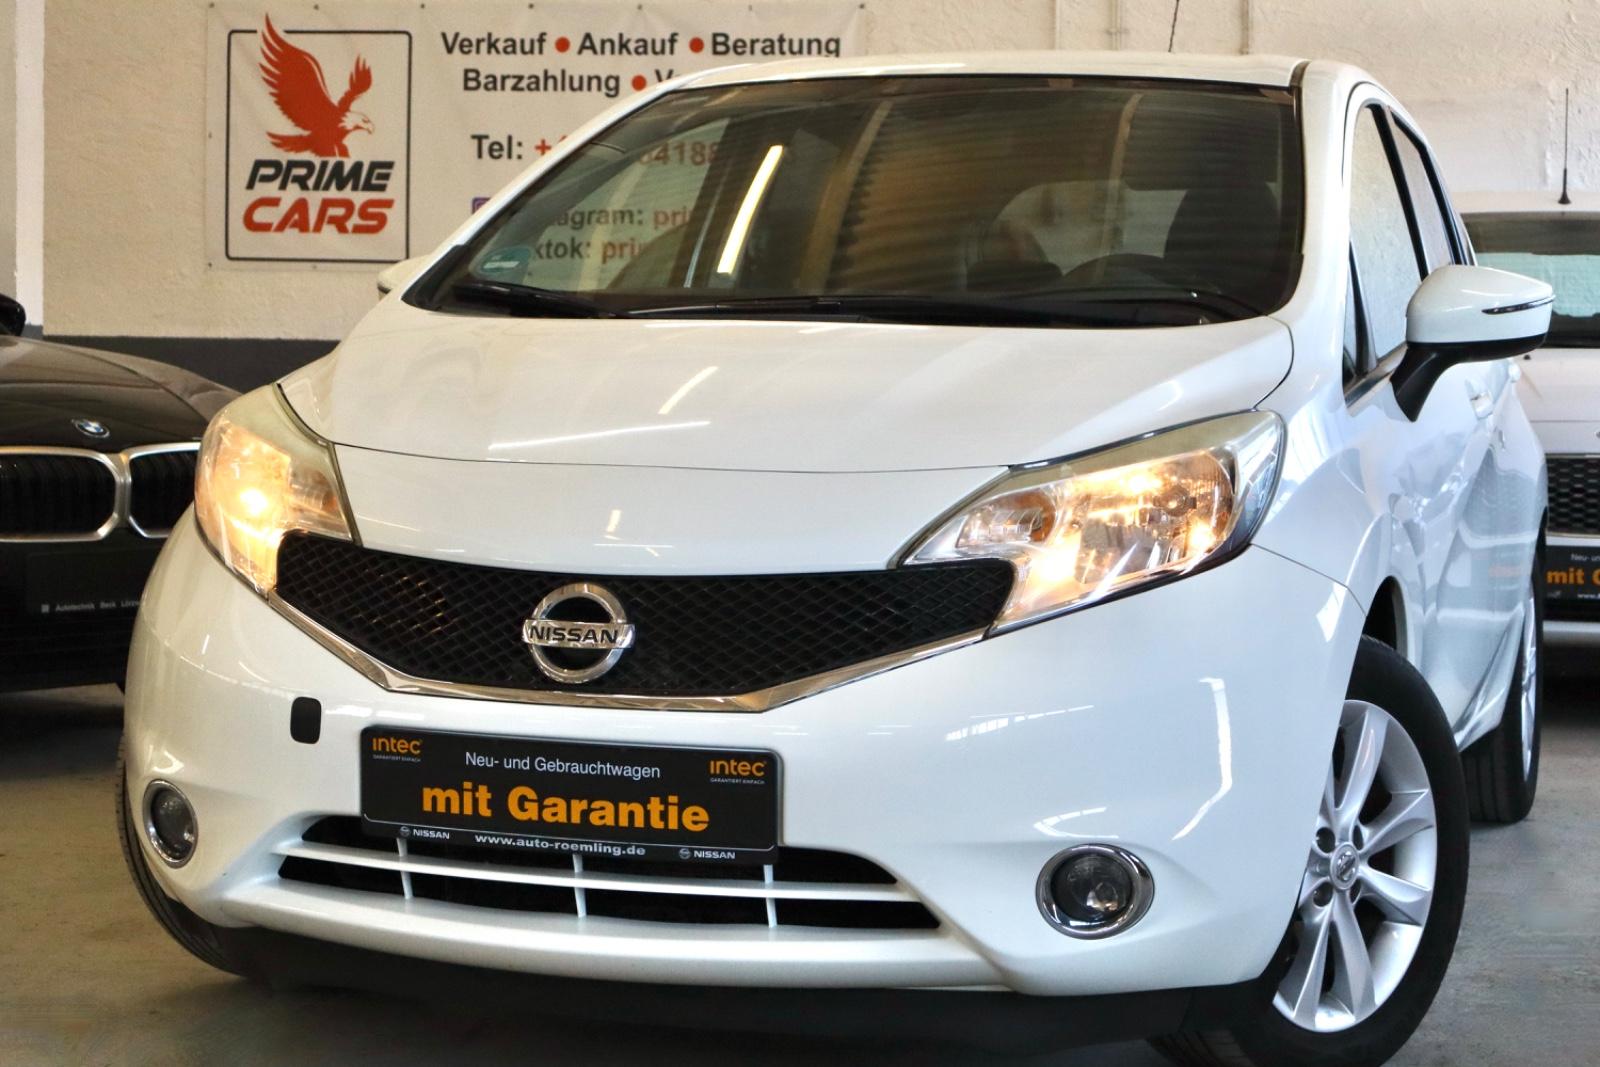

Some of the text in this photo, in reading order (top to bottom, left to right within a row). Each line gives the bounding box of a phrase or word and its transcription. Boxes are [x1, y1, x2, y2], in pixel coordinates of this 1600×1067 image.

[441, 31, 841, 58] Verkauf Ankauf Beratung
[463, 67, 682, 98] Barzahlung V
[471, 134, 524, 160] Tel:
[245, 159, 395, 192] PRIME
[242, 197, 395, 235] CARS
[653, 206, 693, 229] pri
[602, 238, 643, 264] pri
[1546, 567, 1585, 585] mit
[529, 625, 618, 644] NISSAN
[372, 737, 422, 755] intec
[465, 751, 661, 781] Neu- und Gebrauchtwagen
[709, 759, 766, 777] intec
[421, 781, 710, 832] mit Garantie
[412, 827, 451, 840] NISSAN
[475, 833, 646, 857] www.auto-roemling.de
[693, 848, 736, 861] NISSAN
